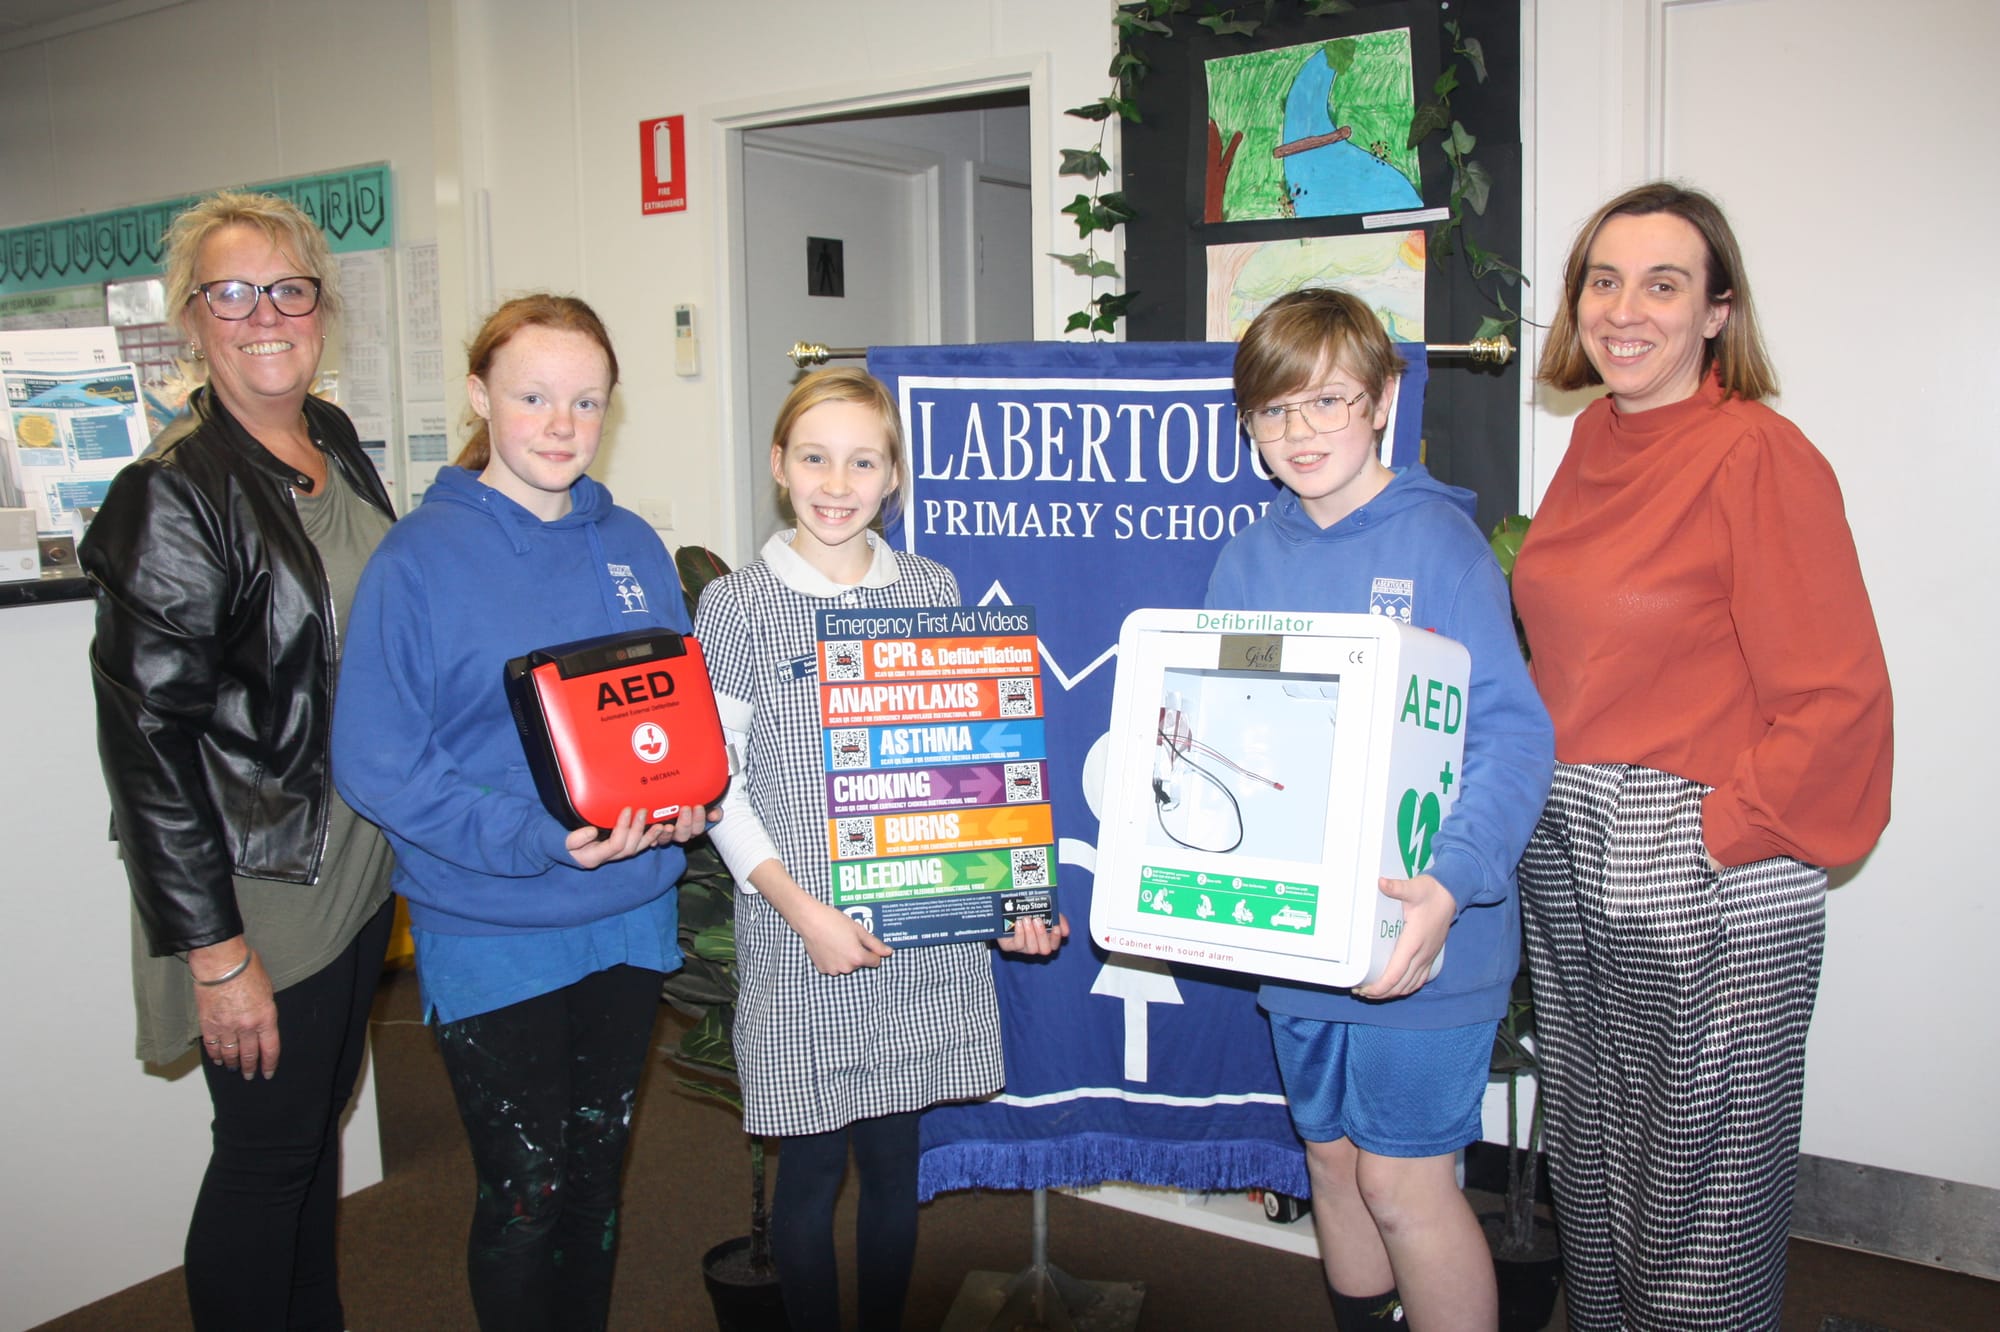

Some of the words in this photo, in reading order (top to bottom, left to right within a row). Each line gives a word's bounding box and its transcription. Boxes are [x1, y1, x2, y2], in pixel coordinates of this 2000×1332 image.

[644, 198, 684, 210] EXTINGUISHER
[658, 187, 672, 196] FIRE
[918, 401, 1270, 484] LABERTOU
[924, 500, 1102, 538] PRIMARY
[826, 614, 913, 639] Emergency
[918, 612, 949, 632] First
[951, 612, 975, 632] Aid
[978, 610, 1028, 631] Videos
[1196, 613, 1314, 632] Defibrillator
[874, 642, 918, 668] CPR
[922, 651, 935, 666] &
[938, 646, 1032, 666] Defibrillation
[597, 671, 675, 712] AED
[828, 682, 980, 714] ANAPHYLAXIS
[1400, 674, 1462, 734] AED
[880, 726, 973, 756] ASTHMA
[833, 771, 931, 803] CHOKING
[885, 813, 960, 844] BURNS
[839, 858, 943, 892] BLEEDING
[1380, 919, 1403, 938] Defi
[1119, 938, 1152, 950] Cabinet
[1156, 944, 1173, 953] with
[1177, 948, 1205, 958] sound
[1208, 952, 1234, 962] alarm
